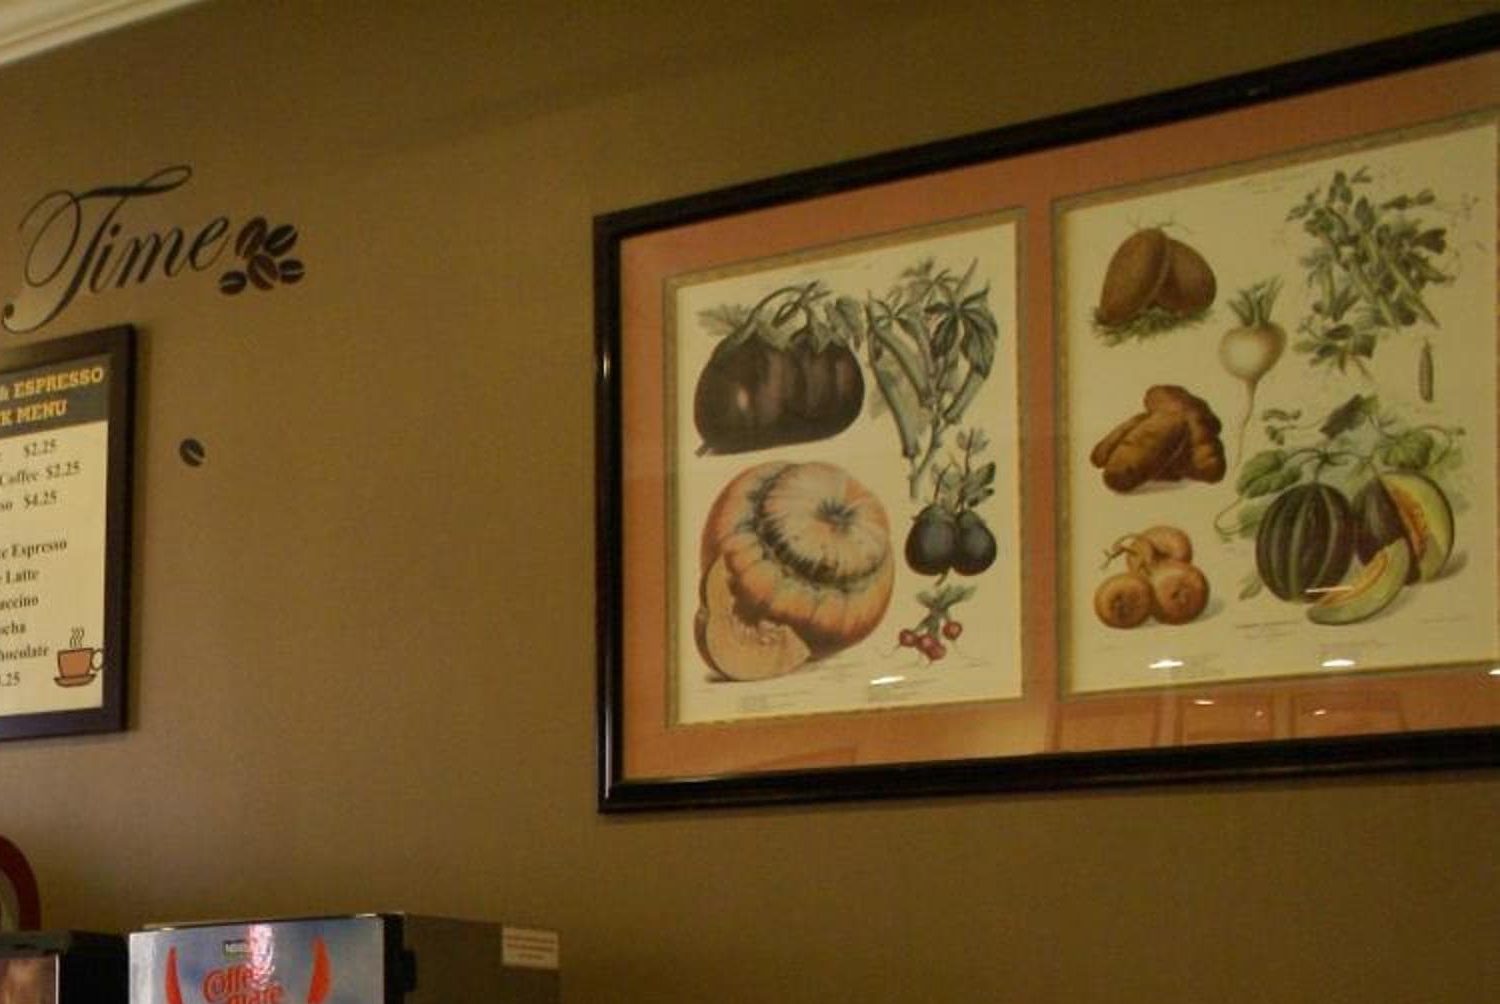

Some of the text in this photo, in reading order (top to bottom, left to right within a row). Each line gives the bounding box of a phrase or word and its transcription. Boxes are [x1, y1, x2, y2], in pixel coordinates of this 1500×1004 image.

[1, 164, 230, 335] Time
[13, 367, 104, 398] ESPRESSO
[16, 399, 68, 423] MENU
[23, 438, 57, 458] $2.25
[45, 459, 80, 480] $2.25
[23, 489, 57, 510] $4.25
[11, 538, 67, 559] Espresso
[5, 567, 40, 585] Latte
